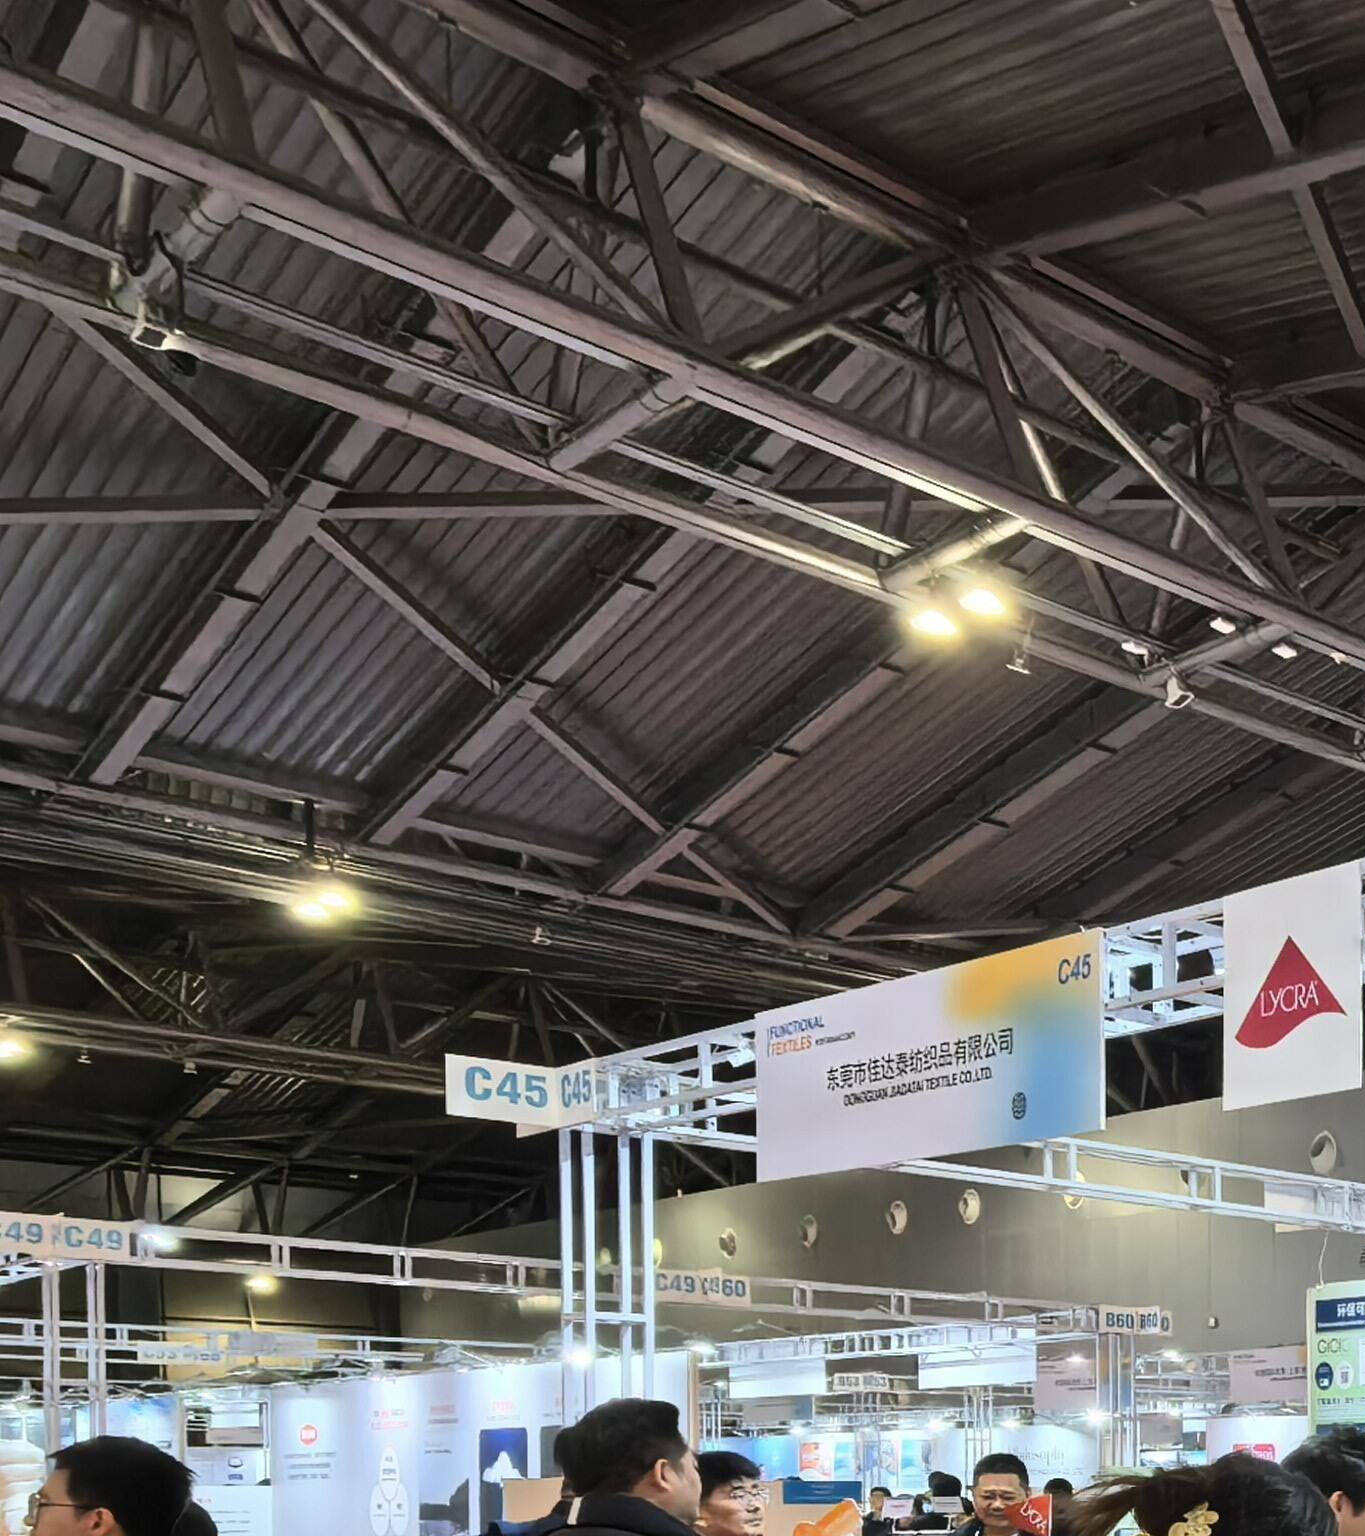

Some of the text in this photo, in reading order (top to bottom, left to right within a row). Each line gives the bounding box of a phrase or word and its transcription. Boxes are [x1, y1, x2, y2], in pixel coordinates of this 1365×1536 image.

[1057, 952, 1092, 985] C45
[1259, 981, 1320, 1019] LYCRA
[826, 1027, 1014, 1091] 东莞市佳达泰纺织品有限公司
[464, 1065, 548, 1109] C45
[561, 1069, 592, 1109] C45
[0, 1221, 43, 1244] 49
[64, 1225, 123, 1250] C49
[656, 1273, 696, 1294] C49
[1106, 1311, 1135, 1329] B60
